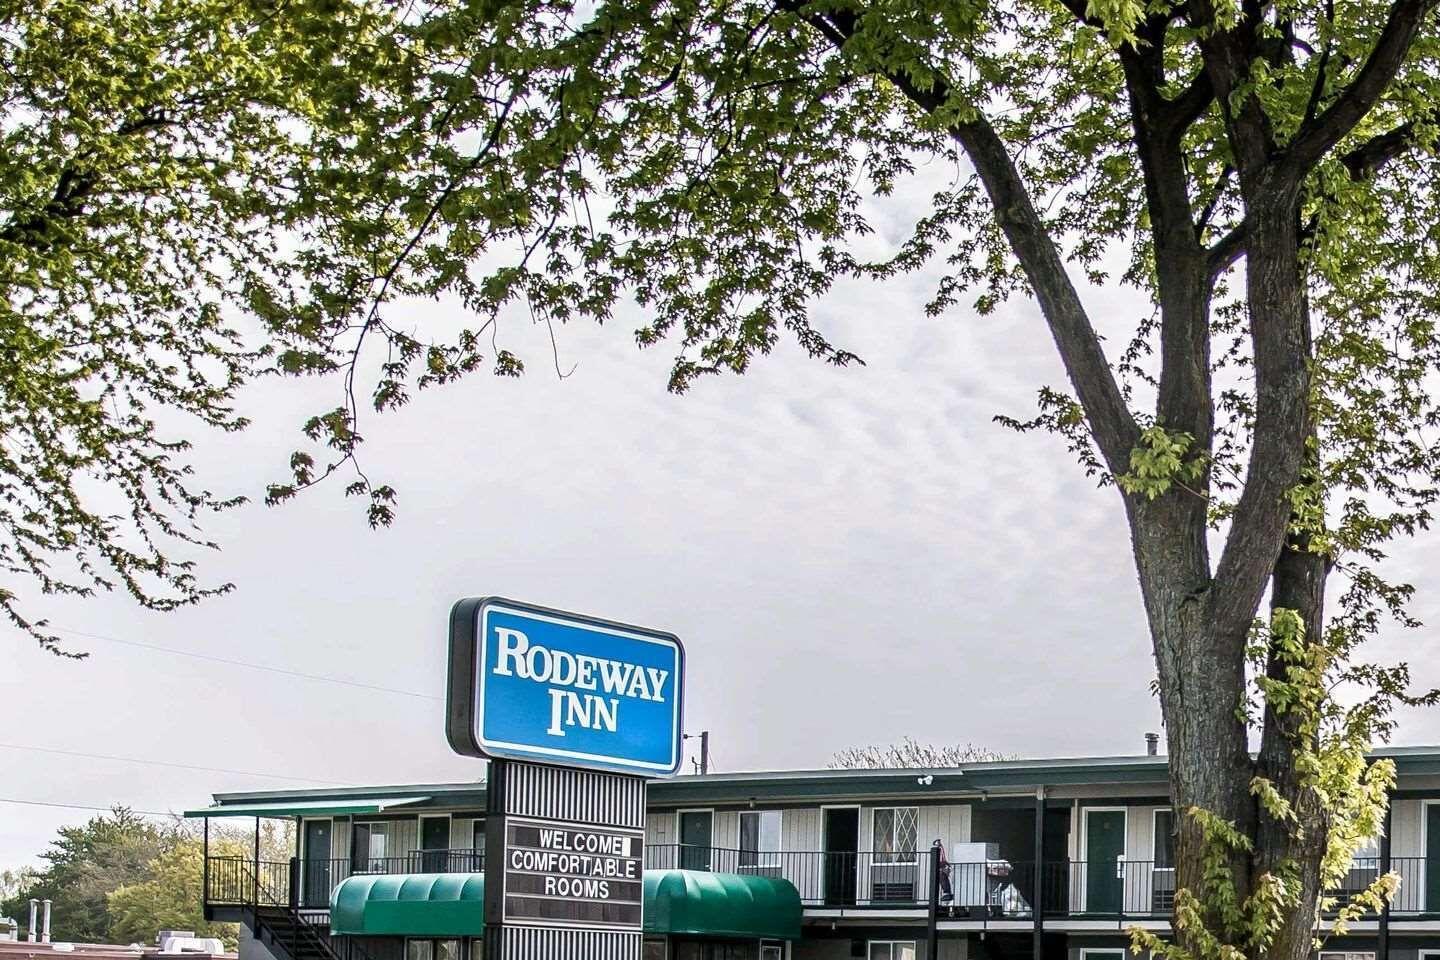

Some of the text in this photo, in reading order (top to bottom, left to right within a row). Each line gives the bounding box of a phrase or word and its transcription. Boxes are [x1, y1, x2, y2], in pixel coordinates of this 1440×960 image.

[493, 626, 668, 702] RODEWAY
[547, 688, 619, 736] INN
[539, 829, 622, 855] WELCOME
[511, 850, 636, 878] COMFORTABLE
[545, 877, 609, 899] ROOMS
